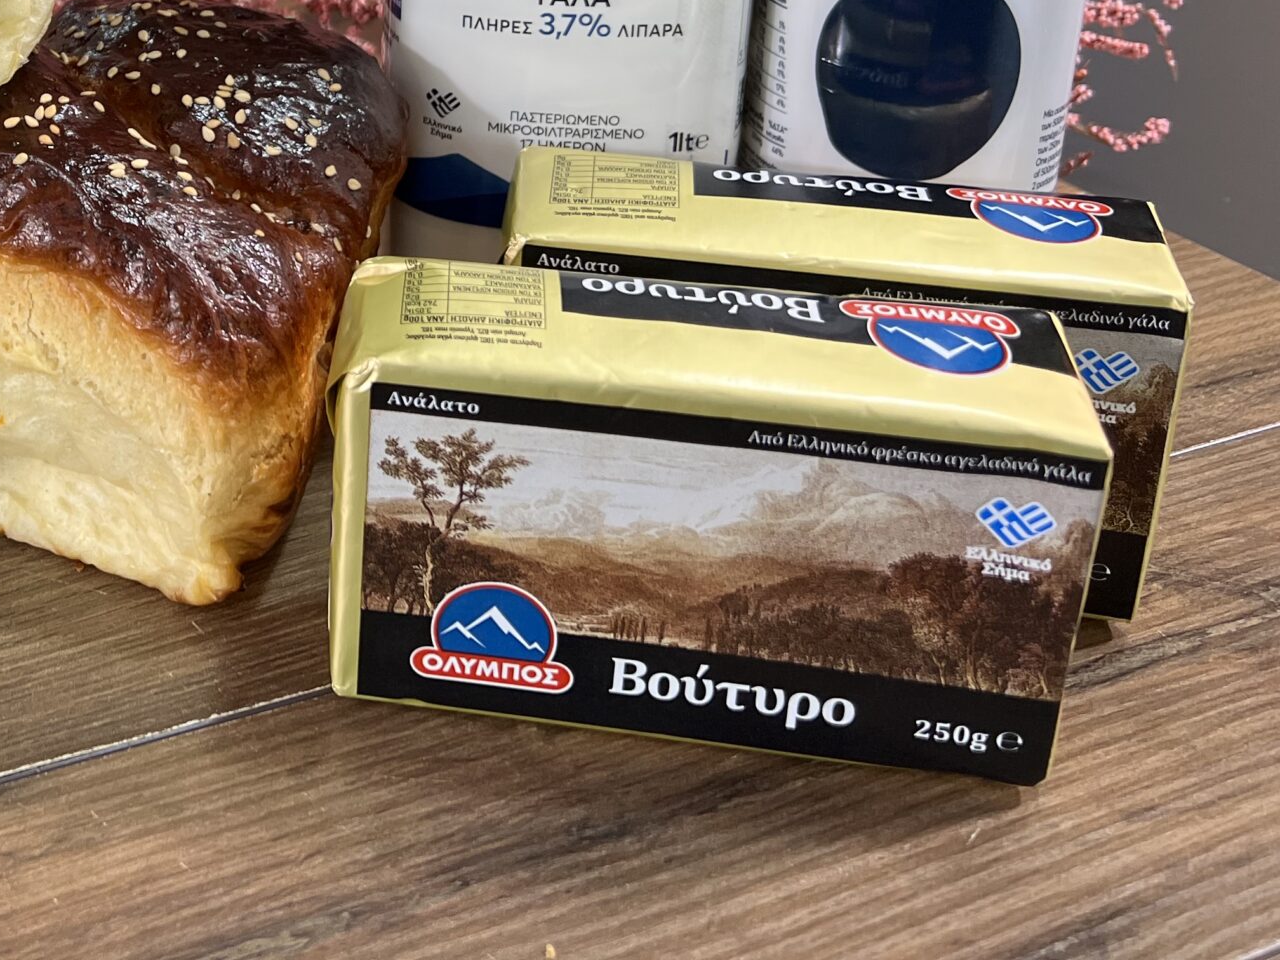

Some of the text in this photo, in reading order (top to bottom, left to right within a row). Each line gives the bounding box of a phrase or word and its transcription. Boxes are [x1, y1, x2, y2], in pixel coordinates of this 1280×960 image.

[461, 13, 684, 40] ΠΛΗΡΕΣ 3,7% ΛΙΠΑΡΑ
[487, 121, 645, 140] ΜΙΚΡΟΦΙΛΤΡΑΡΙΣΜΕΝΟ
[509, 110, 621, 127] ΠΑΣΤΕΡΙΩΜΕΝΟ
[712, 168, 933, 203] Βούτυρο
[956, 189, 1102, 213] ΟΛΥΜΠΟΣ
[536, 252, 620, 274] Ανάλατο
[581, 276, 826, 324] Βούτυρο
[855, 304, 1009, 332] ΟΛΥΜΠΟΣ
[1127, 310, 1171, 331] γάλα
[387, 390, 480, 416] Ανάλατο
[1093, 399, 1136, 414] ηνικό
[747, 430, 1092, 484] Από Ελληνικό φρέσκο αγελαδινό γάλα
[965, 545, 1052, 571] Ελληνικό
[980, 561, 1031, 582] Σήμα
[421, 652, 560, 686] ΟΛΥΜΠΟΣ
[607, 655, 857, 730] Βούτυρο
[914, 718, 990, 752] 250g
